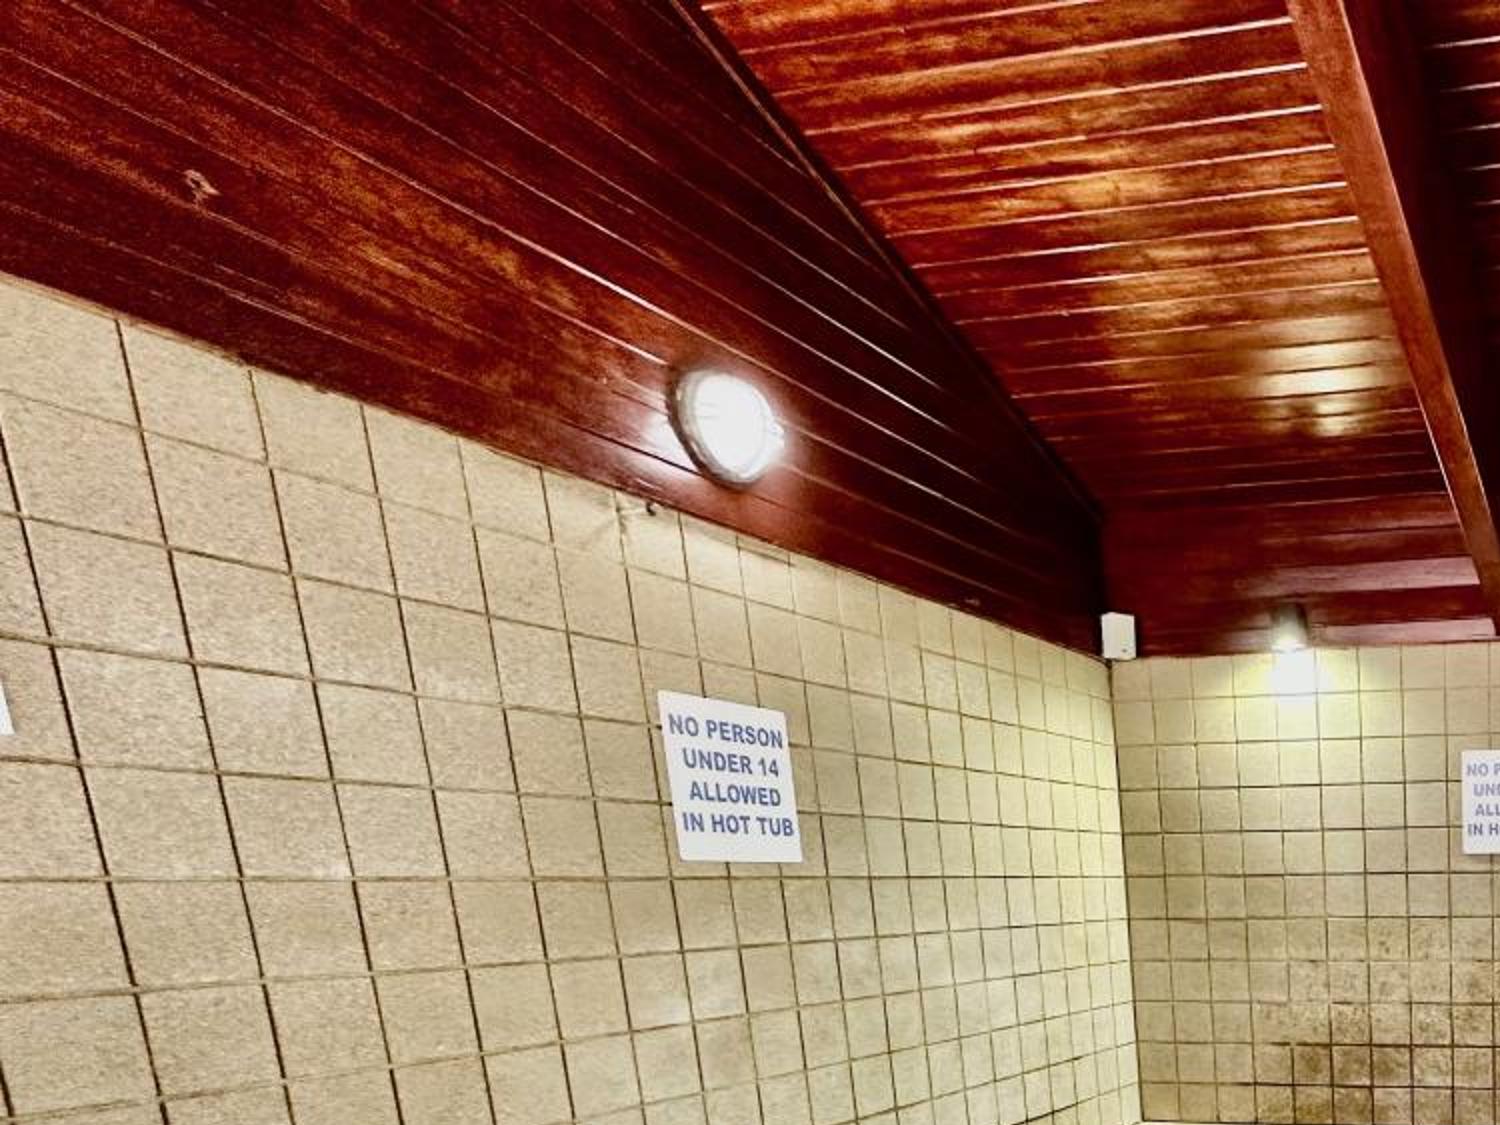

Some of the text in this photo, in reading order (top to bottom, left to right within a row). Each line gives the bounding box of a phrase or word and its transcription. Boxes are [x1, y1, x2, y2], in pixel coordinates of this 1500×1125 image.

[668, 713, 783, 749] NO PERSON
[682, 747, 779, 777] UNDER 14
[1466, 763, 1489, 777] NO
[689, 781, 781, 807] ALLOWED
[682, 812, 795, 837] IN HOT TUB
[1467, 823, 1483, 836] IN
